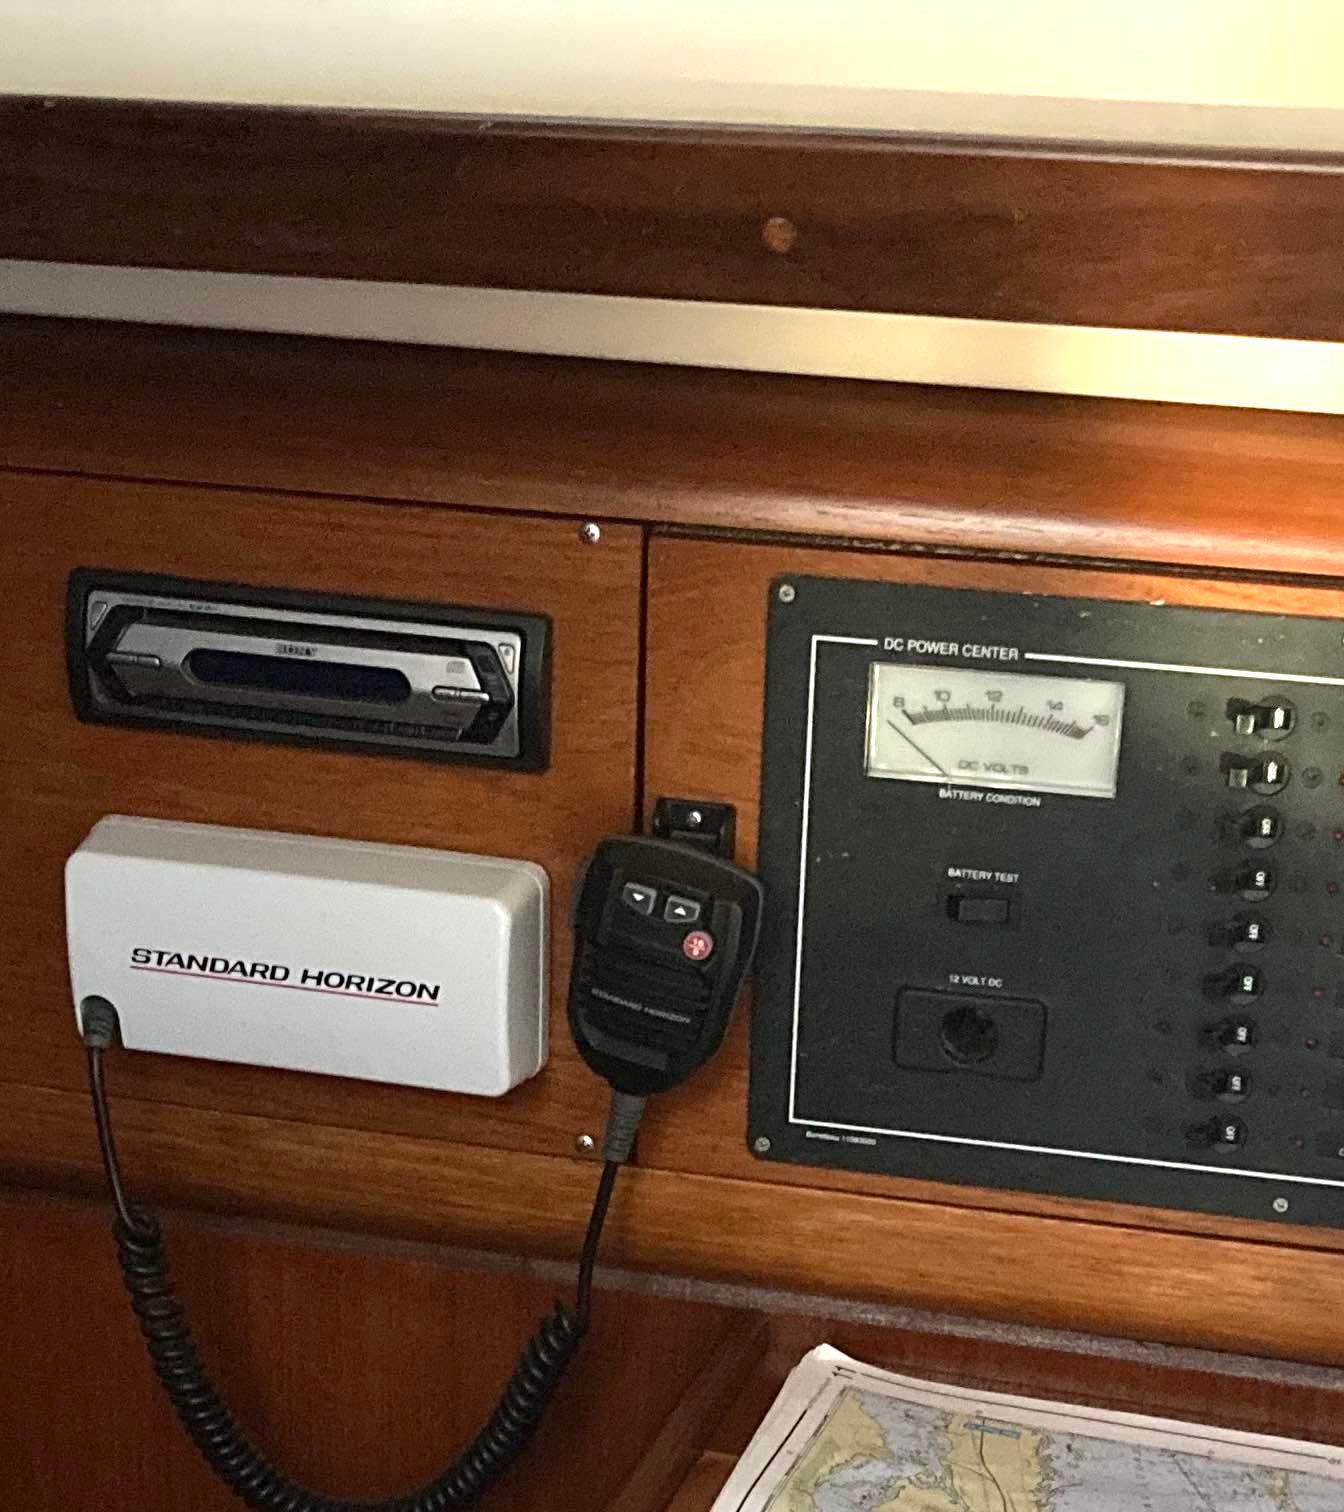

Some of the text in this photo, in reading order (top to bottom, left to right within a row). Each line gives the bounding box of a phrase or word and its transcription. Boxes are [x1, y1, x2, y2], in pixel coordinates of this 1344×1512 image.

[883, 637, 1019, 661] DC POWER CENTER
[933, 689, 951, 702] 10
[985, 690, 1003, 703] 12
[957, 759, 1030, 775] DC VOLTS
[939, 788, 1041, 807] BATTERY CONDITION
[947, 867, 1020, 884] BATTERY TEST
[131, 947, 441, 1001] STANDARD HORIZON
[948, 974, 1004, 988] 12 VOLT DC
